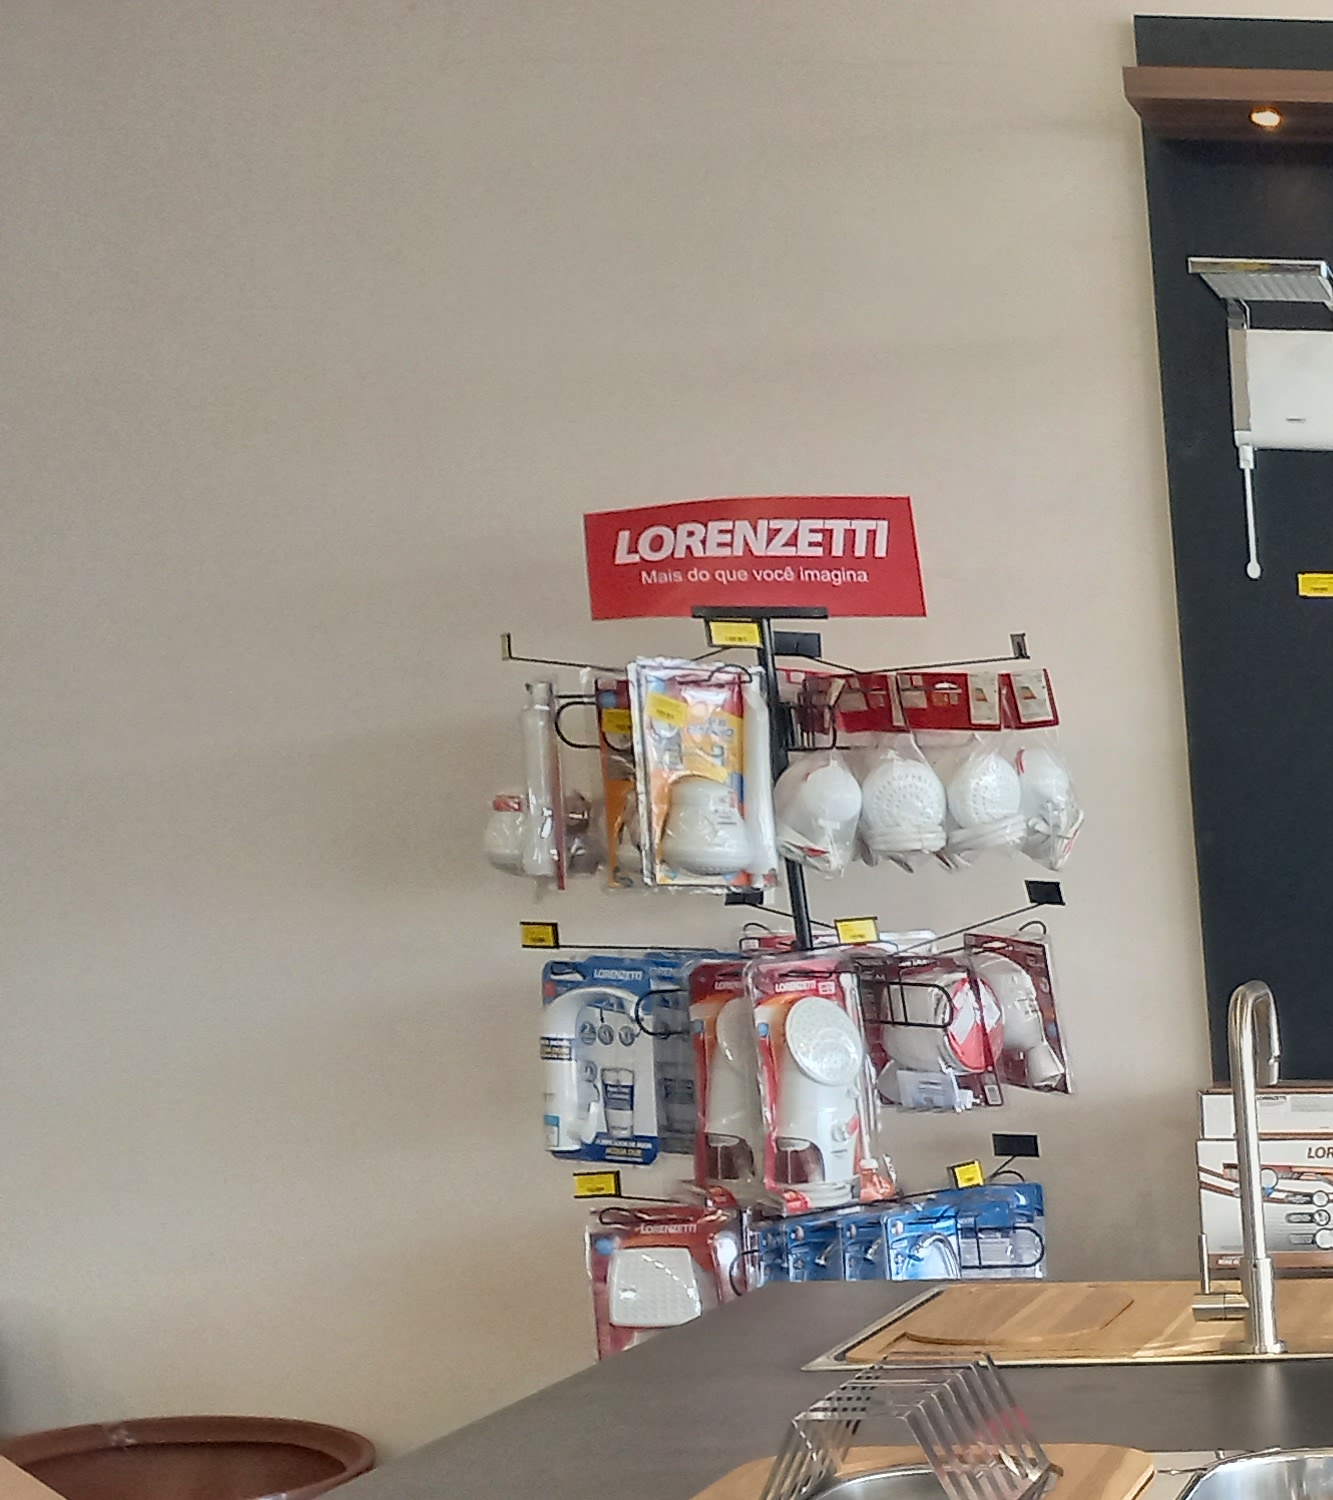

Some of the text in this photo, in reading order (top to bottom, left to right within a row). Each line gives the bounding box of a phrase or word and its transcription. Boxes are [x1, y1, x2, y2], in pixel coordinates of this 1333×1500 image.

[613, 518, 889, 565] LORENZETTI
[641, 565, 869, 585] Mais do que você imagina
[639, 1222, 698, 1235] LORENZETTI
